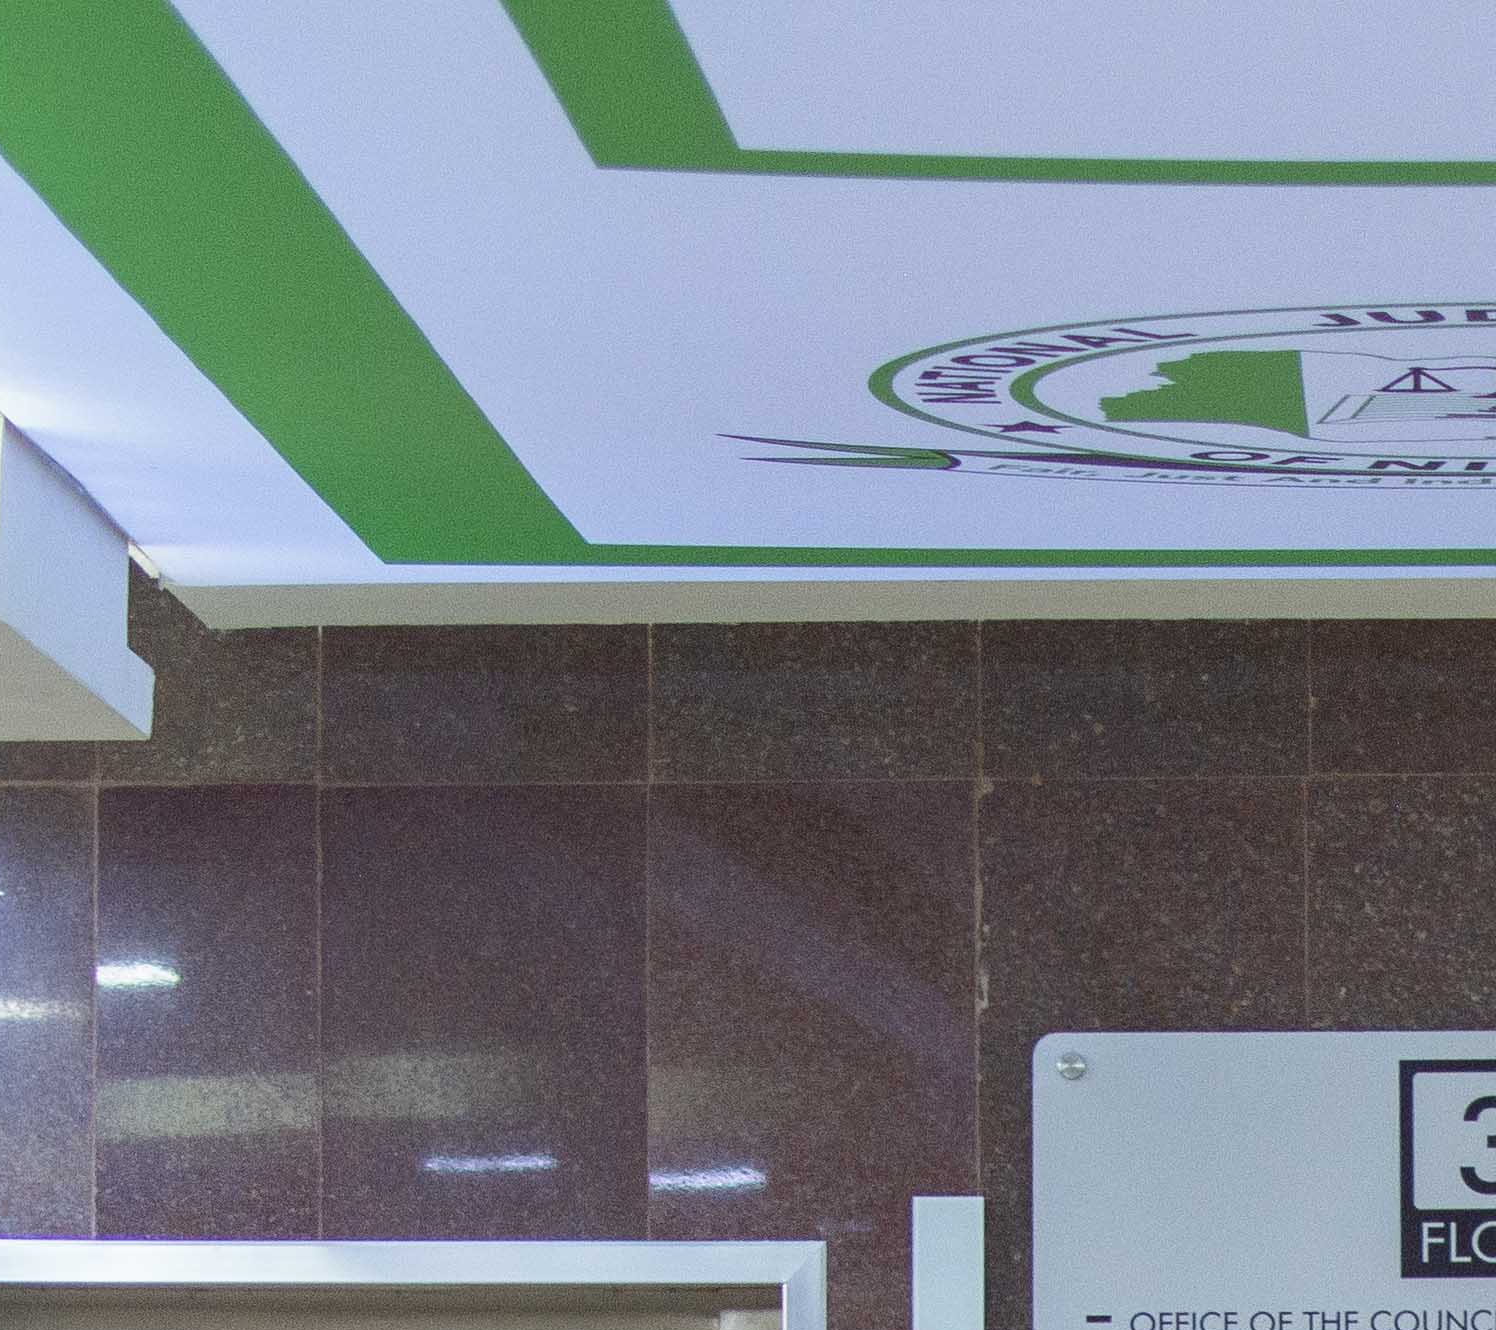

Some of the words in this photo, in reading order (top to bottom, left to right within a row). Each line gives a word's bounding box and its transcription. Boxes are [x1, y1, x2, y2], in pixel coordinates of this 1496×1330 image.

[913, 327, 1199, 405] NATIONAL
[1189, 450, 1342, 466] OF
[1124, 471, 1243, 482] Just
[1276, 475, 1382, 486] And
